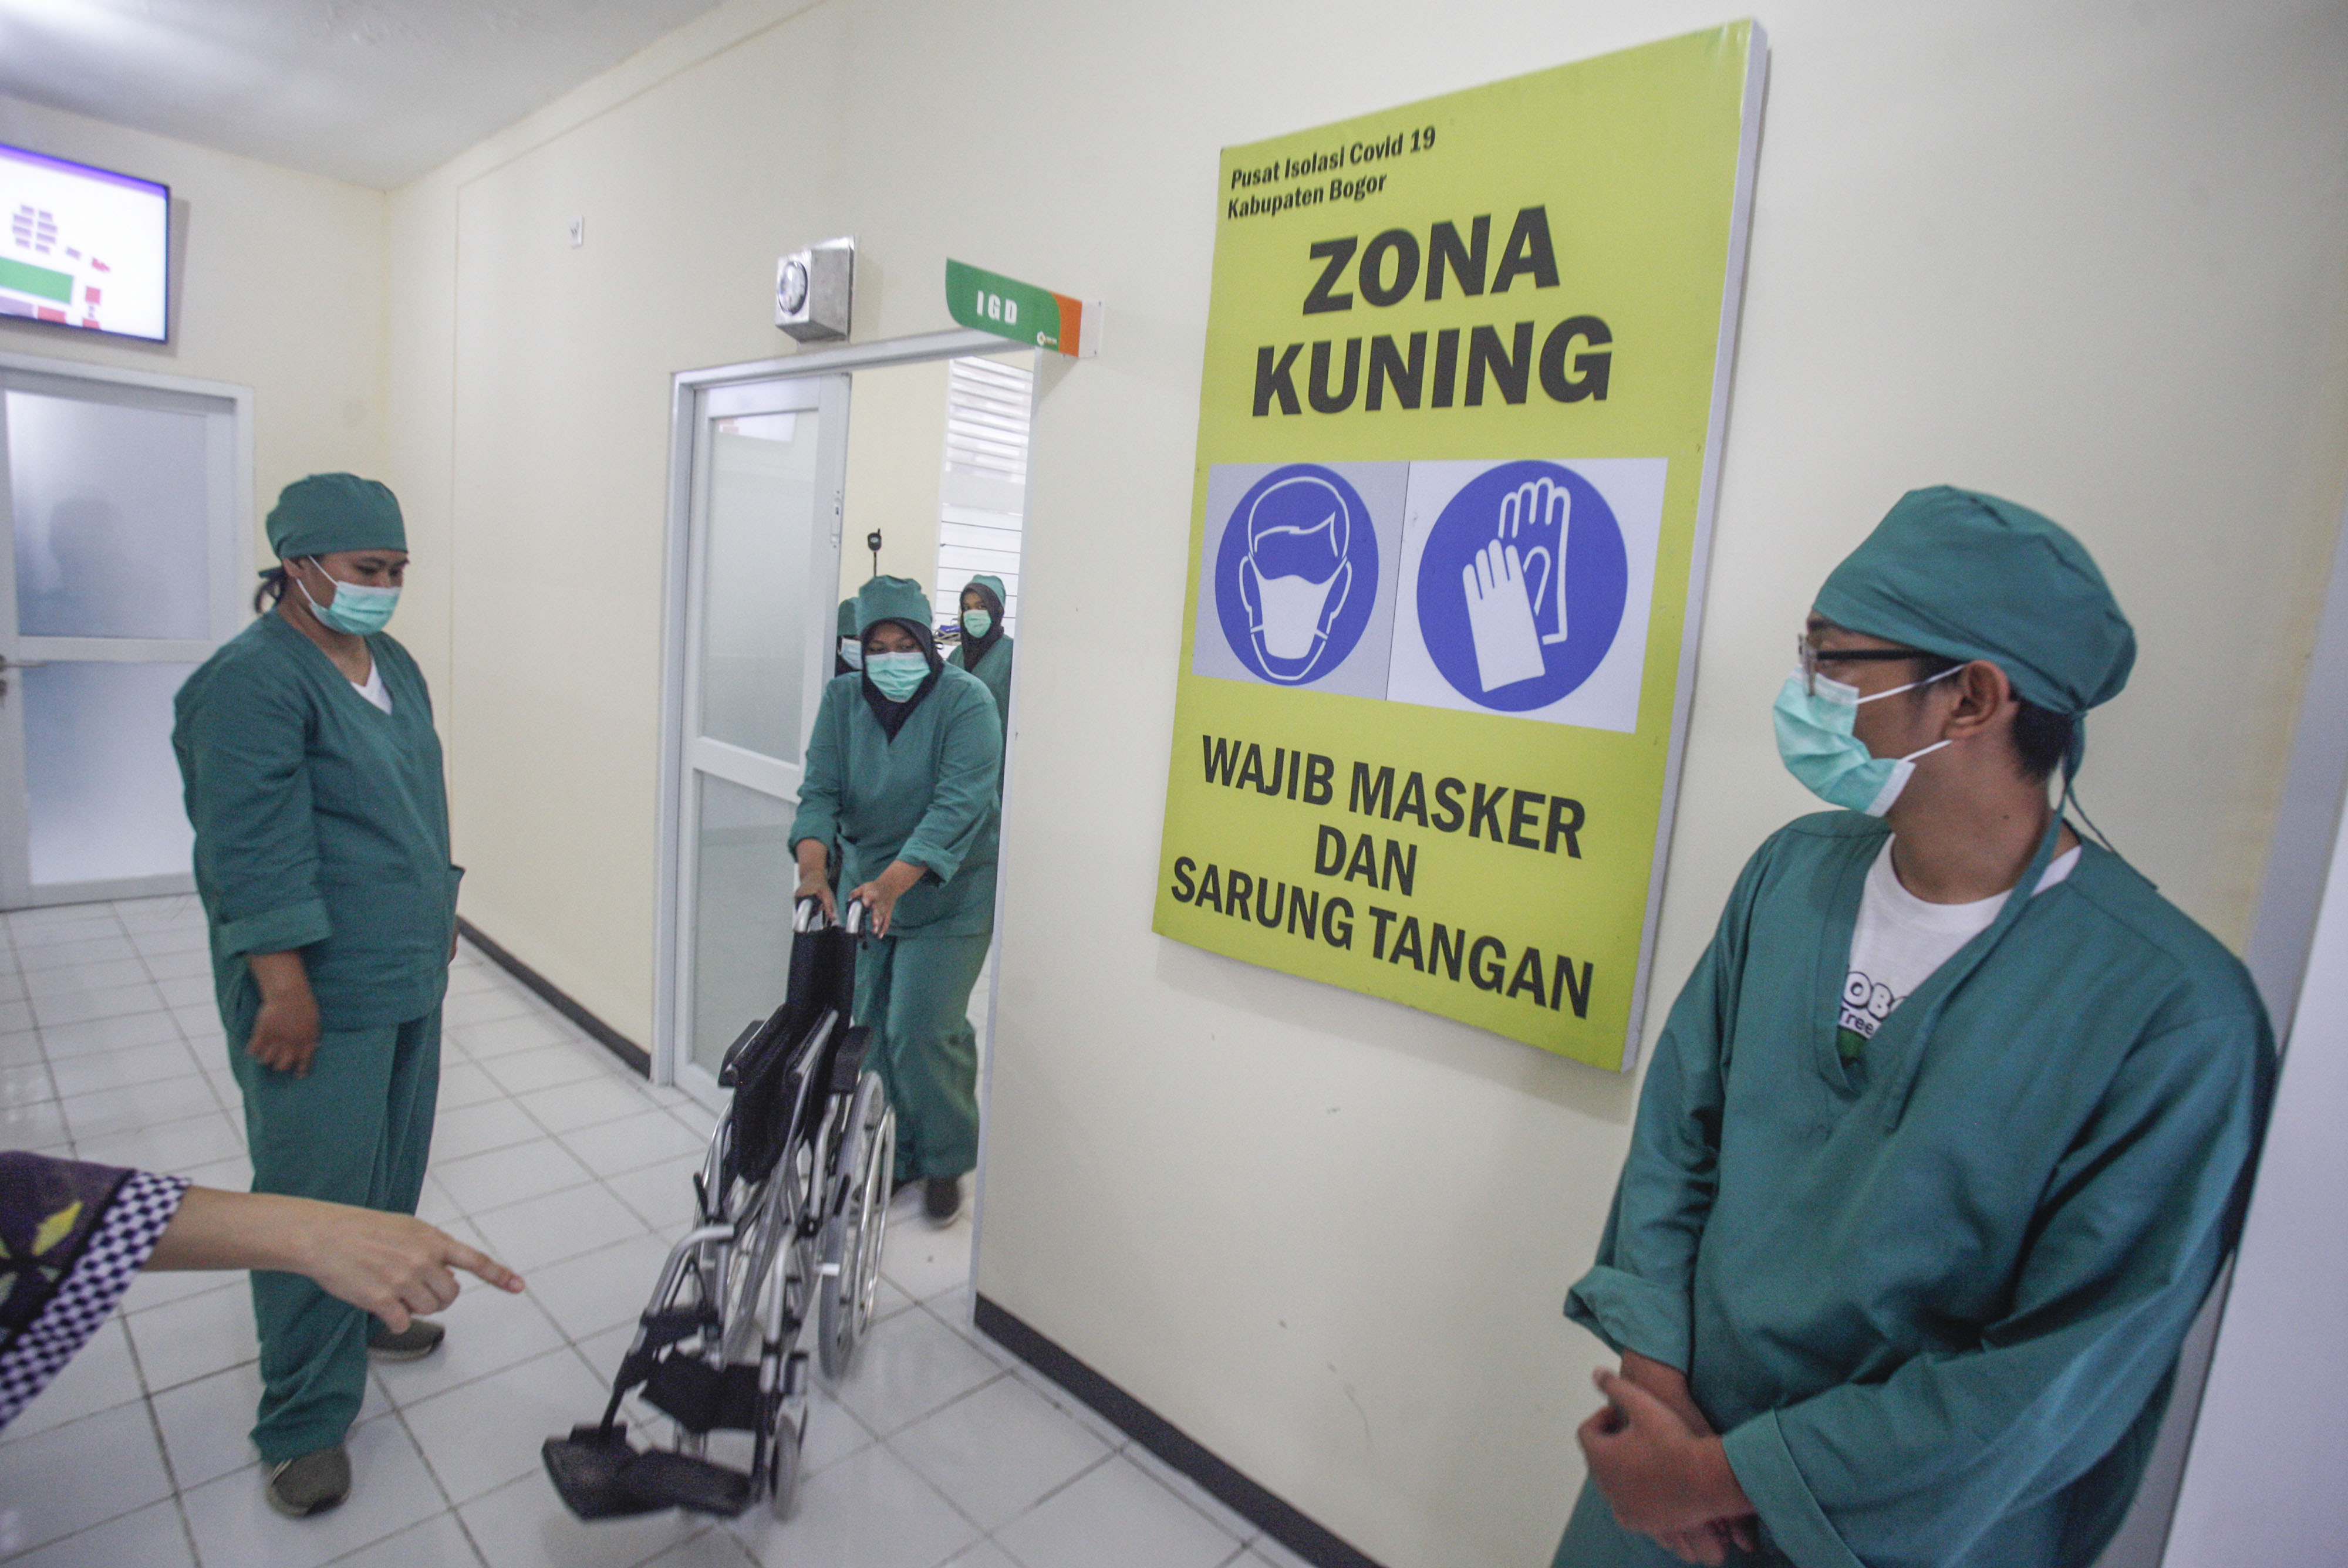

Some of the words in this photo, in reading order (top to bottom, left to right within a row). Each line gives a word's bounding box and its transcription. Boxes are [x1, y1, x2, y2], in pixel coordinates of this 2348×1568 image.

[1231, 160, 1280, 190] Pusat
[1284, 145, 1345, 179] Isolasi
[1350, 133, 1404, 165] Covid
[1409, 126, 1436, 153] 19
[1227, 188, 1324, 219] Kabupaten
[1329, 174, 1387, 201] Bogor
[1302, 205, 1560, 316] ZONA
[976, 290, 1018, 325] IGD
[1252, 315, 1612, 417] KUNING
[1202, 734, 1335, 806] WAJIB
[1348, 761, 1586, 860] MASKER
[1314, 824, 1418, 897] DAN
[1170, 856, 1354, 951] SARUNG
[1368, 905, 1594, 1020] TANGAN
[1842, 971, 1906, 1020] OB
